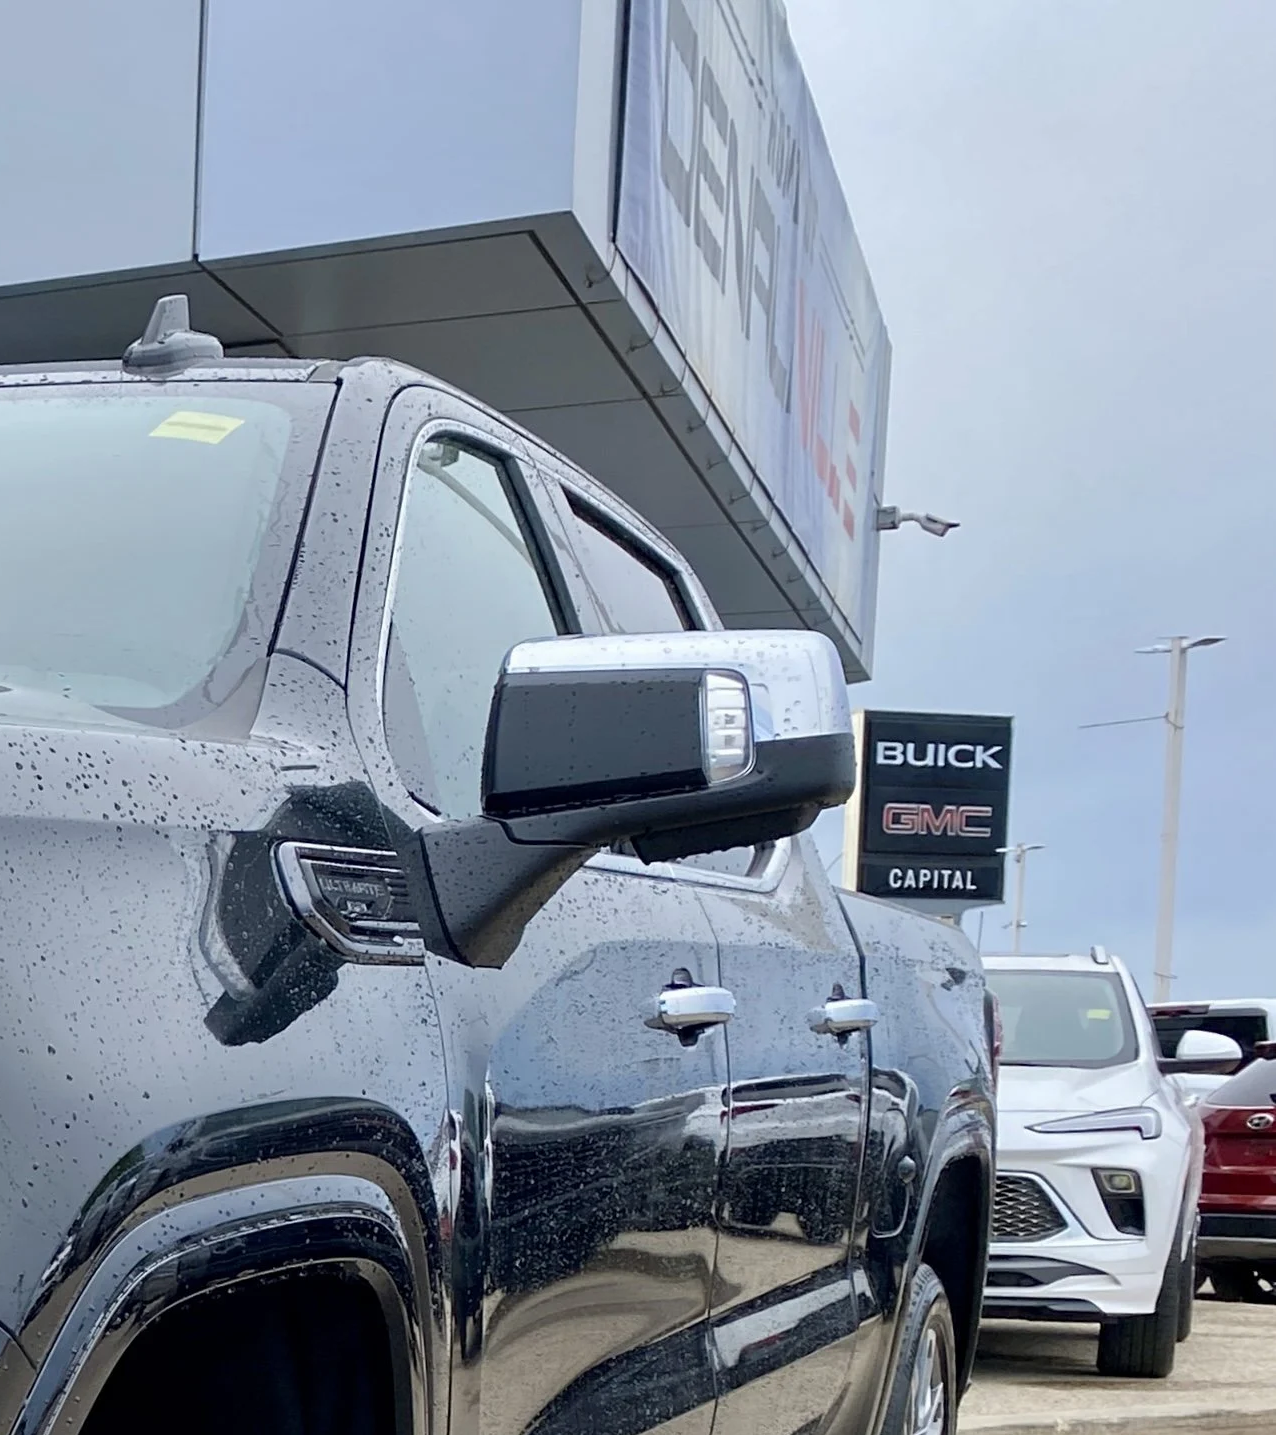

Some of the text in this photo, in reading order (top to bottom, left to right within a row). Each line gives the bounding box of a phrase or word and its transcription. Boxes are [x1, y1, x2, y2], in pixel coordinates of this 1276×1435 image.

[876, 741, 1003, 769] BUICK
[882, 803, 993, 838] GMC
[888, 867, 977, 890] CAPITAL
